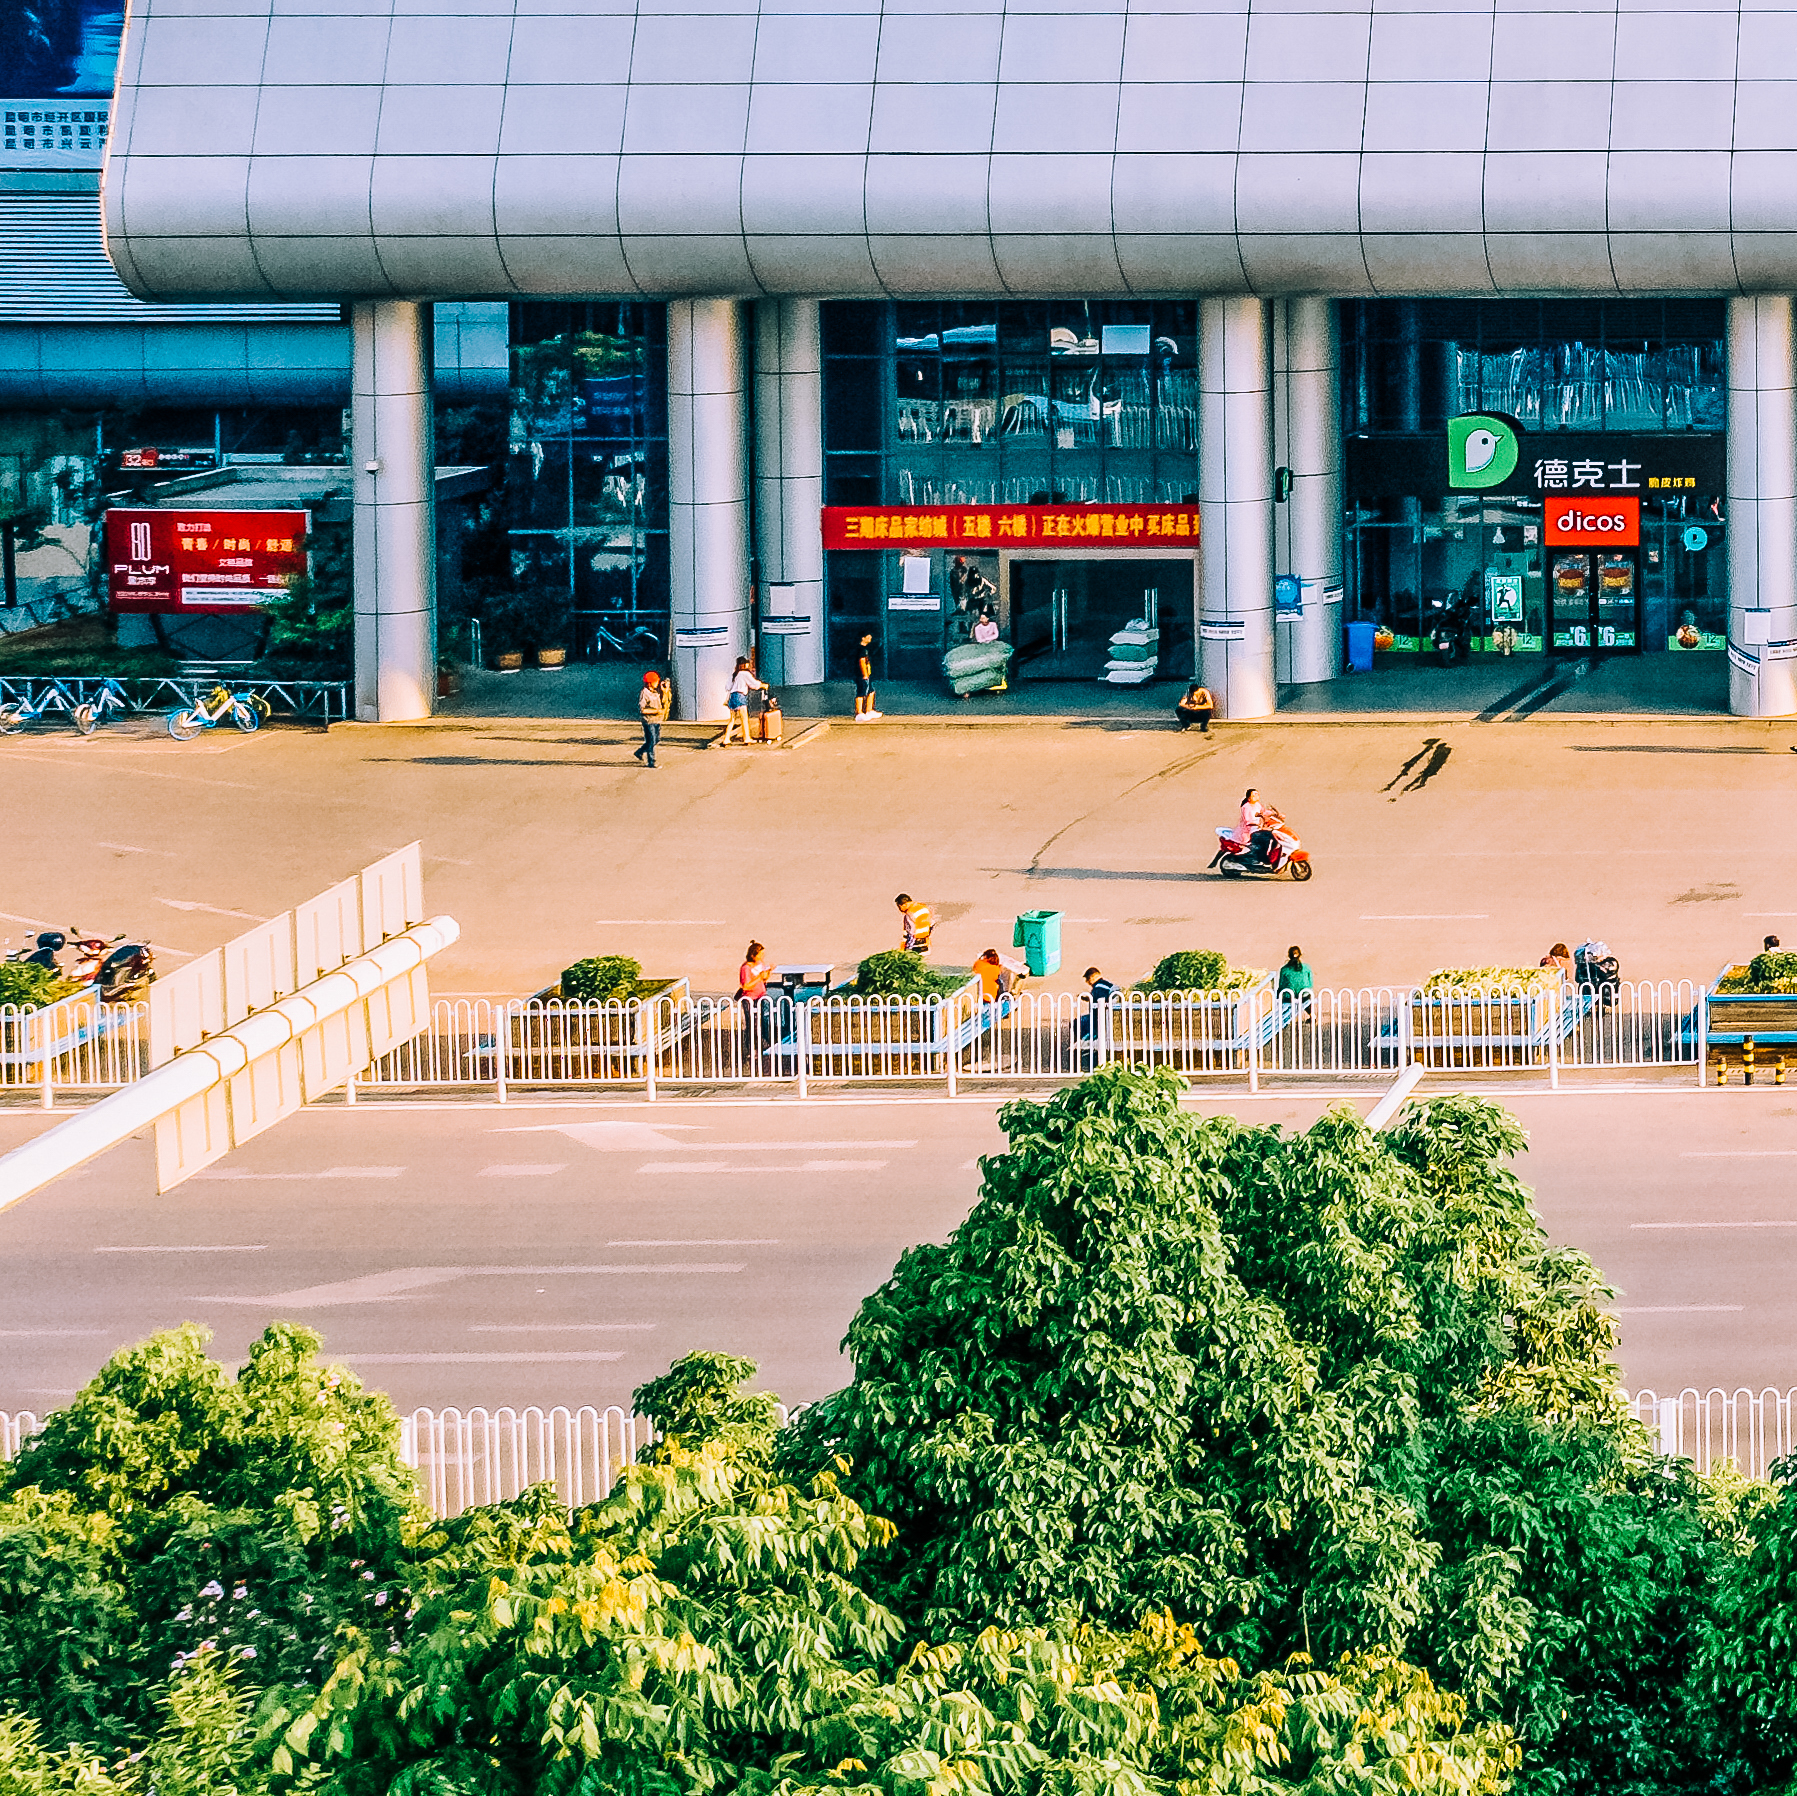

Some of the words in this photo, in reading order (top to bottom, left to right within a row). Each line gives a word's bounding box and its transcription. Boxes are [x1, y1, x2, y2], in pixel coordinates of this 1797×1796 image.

[1534, 459, 1641, 488] 德克士
[1557, 510, 1626, 532] dicos
[114, 565, 170, 574] PLUM
